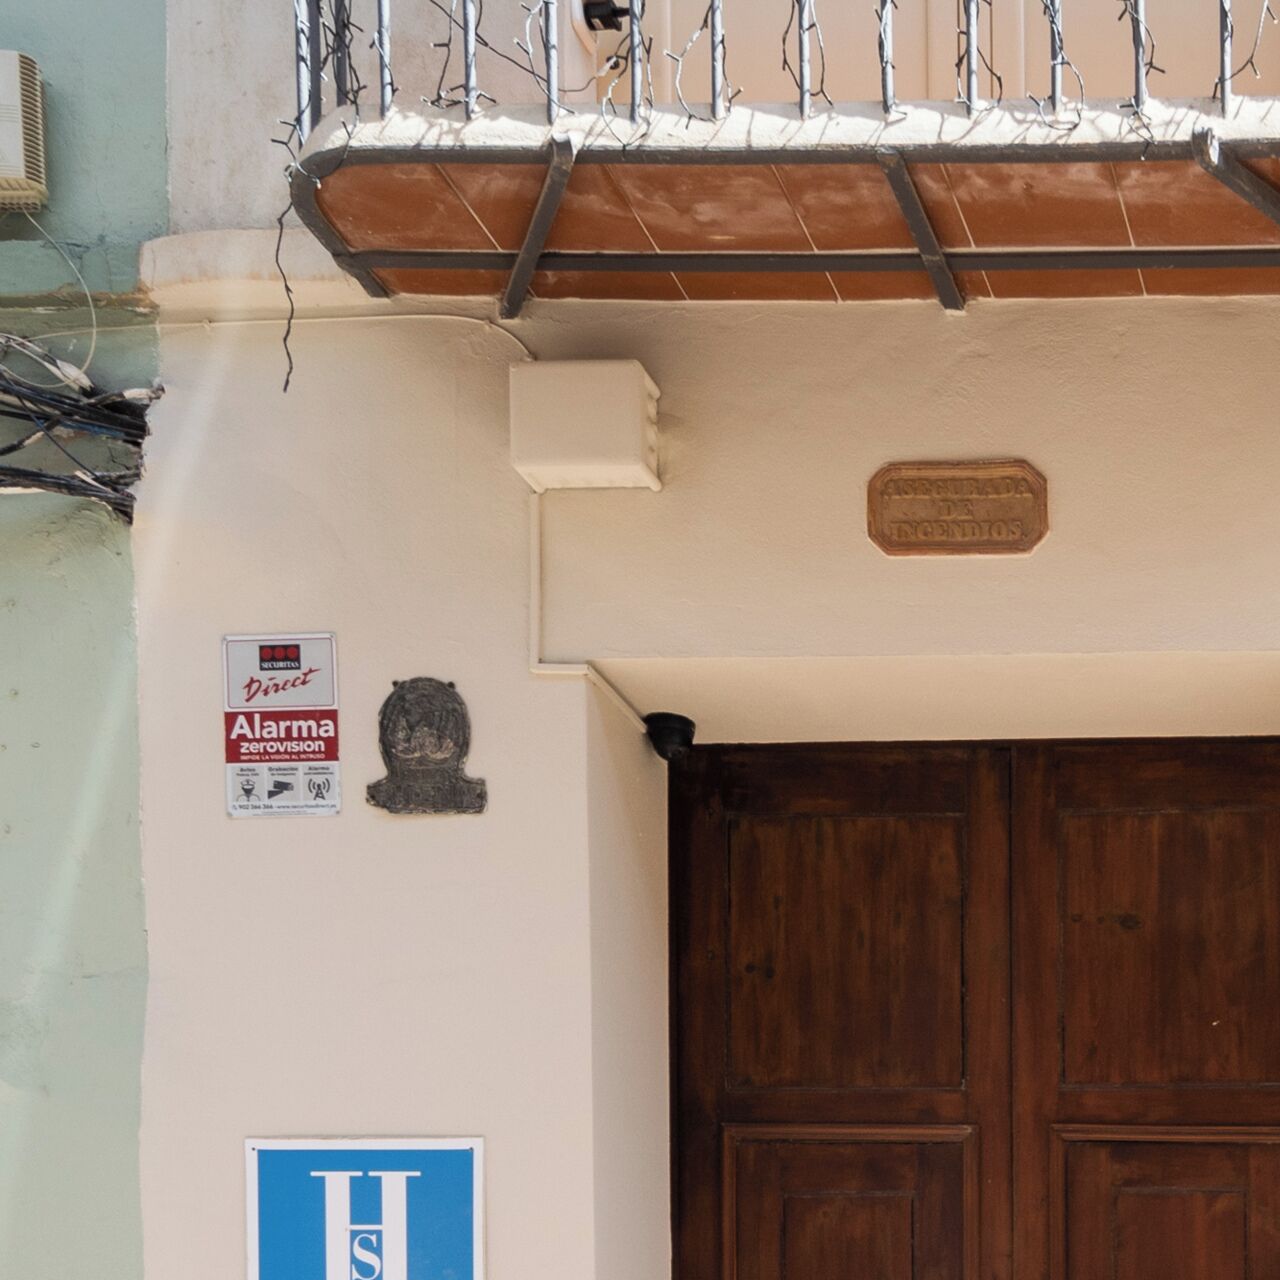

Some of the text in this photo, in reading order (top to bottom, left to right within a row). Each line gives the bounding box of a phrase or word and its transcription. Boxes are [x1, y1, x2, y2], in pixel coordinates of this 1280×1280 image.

[883, 479, 1032, 499] ASEGURADA
[939, 500, 974, 520] DE
[890, 520, 1024, 542] INCENDIOS
[261, 660, 300, 669] SECURITAS
[242, 667, 321, 703] Direct
[230, 713, 335, 740] Alarma
[240, 740, 326, 754] zerovision
